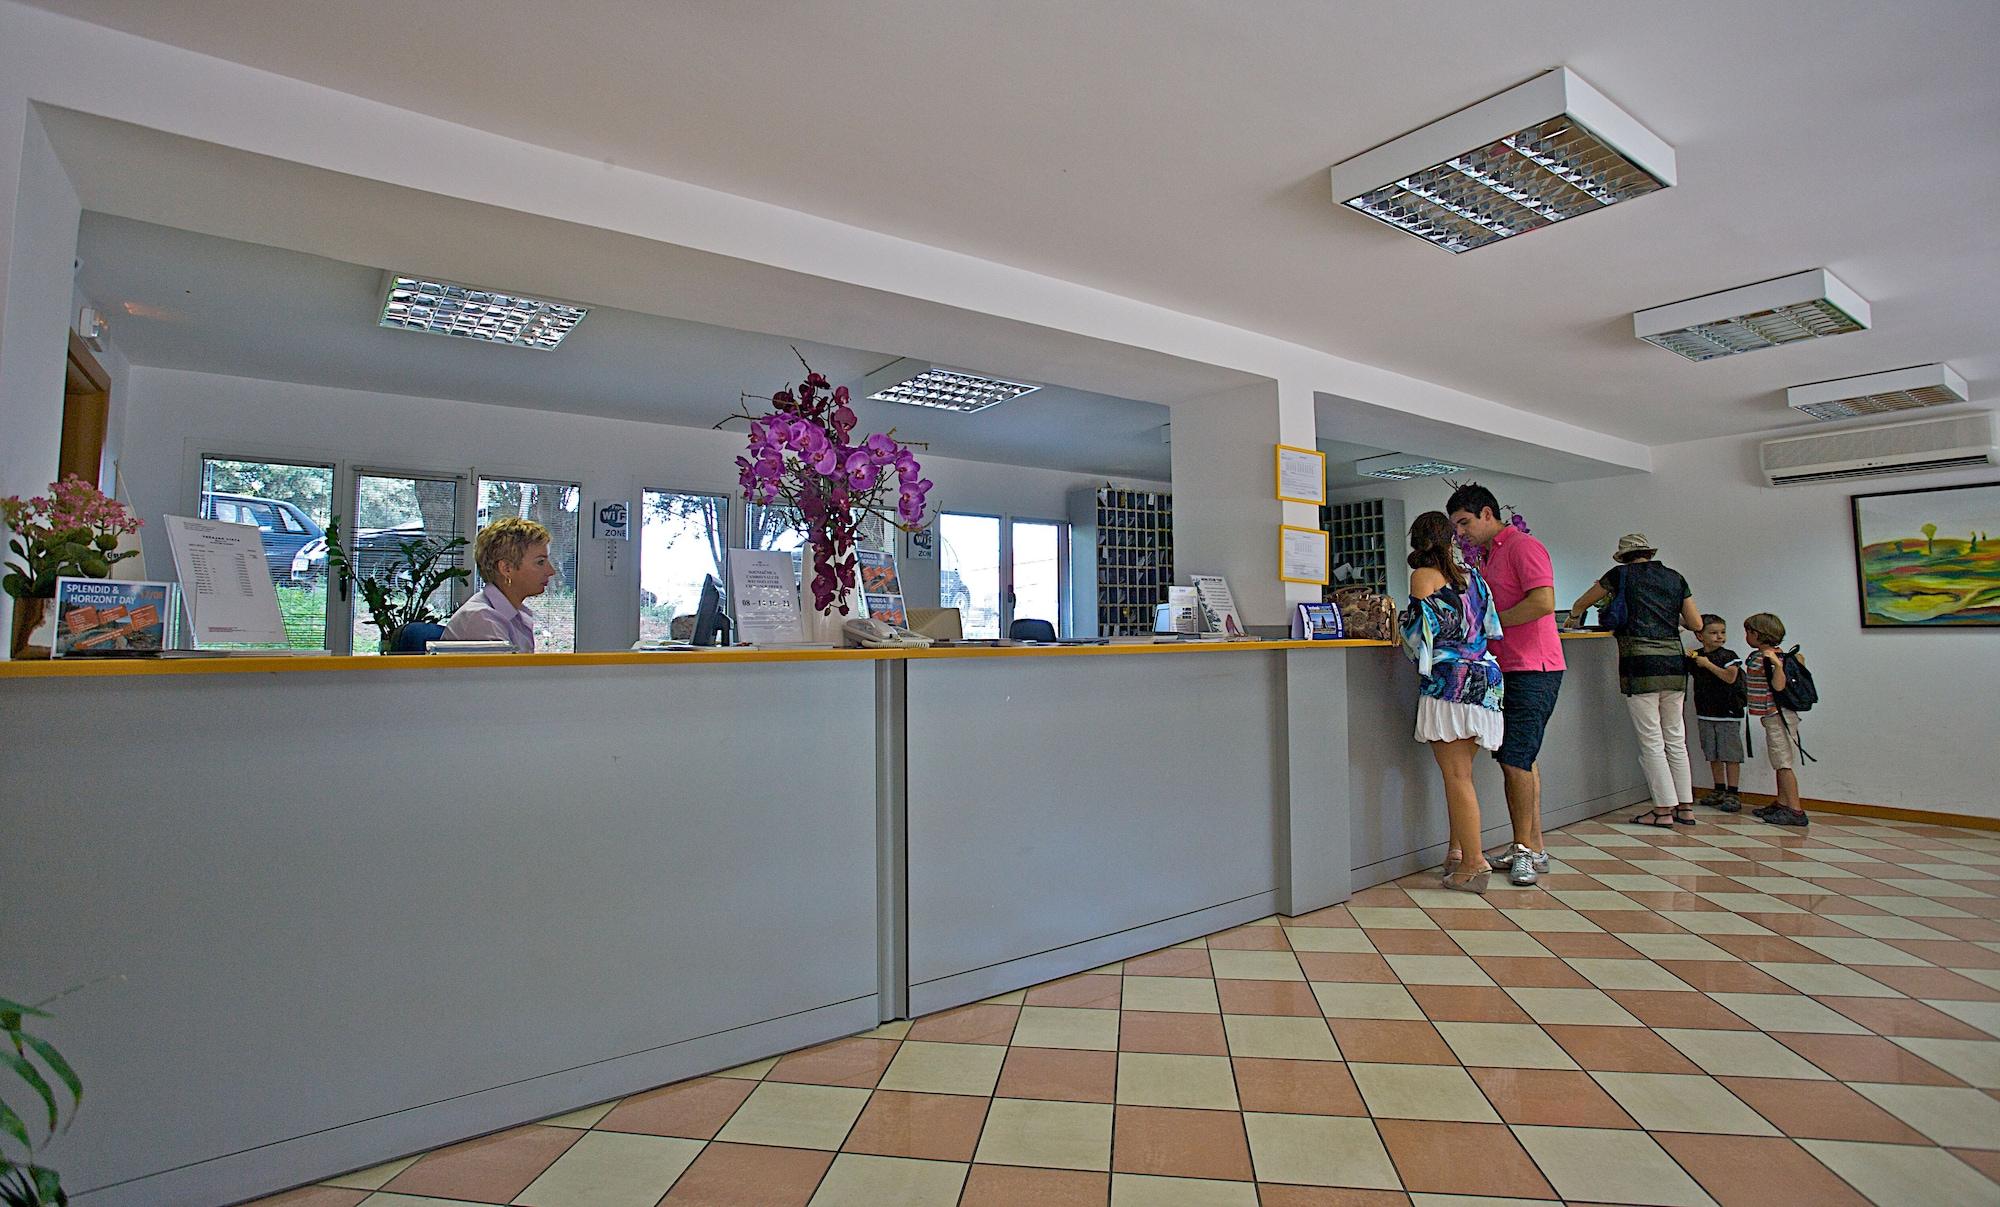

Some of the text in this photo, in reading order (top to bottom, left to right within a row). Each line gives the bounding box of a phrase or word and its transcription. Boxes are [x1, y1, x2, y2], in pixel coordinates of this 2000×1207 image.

[602, 508, 627, 521] WiF
[67, 584, 120, 594] SPLENDID &
[70, 594, 137, 605] HORIZONT DAY
